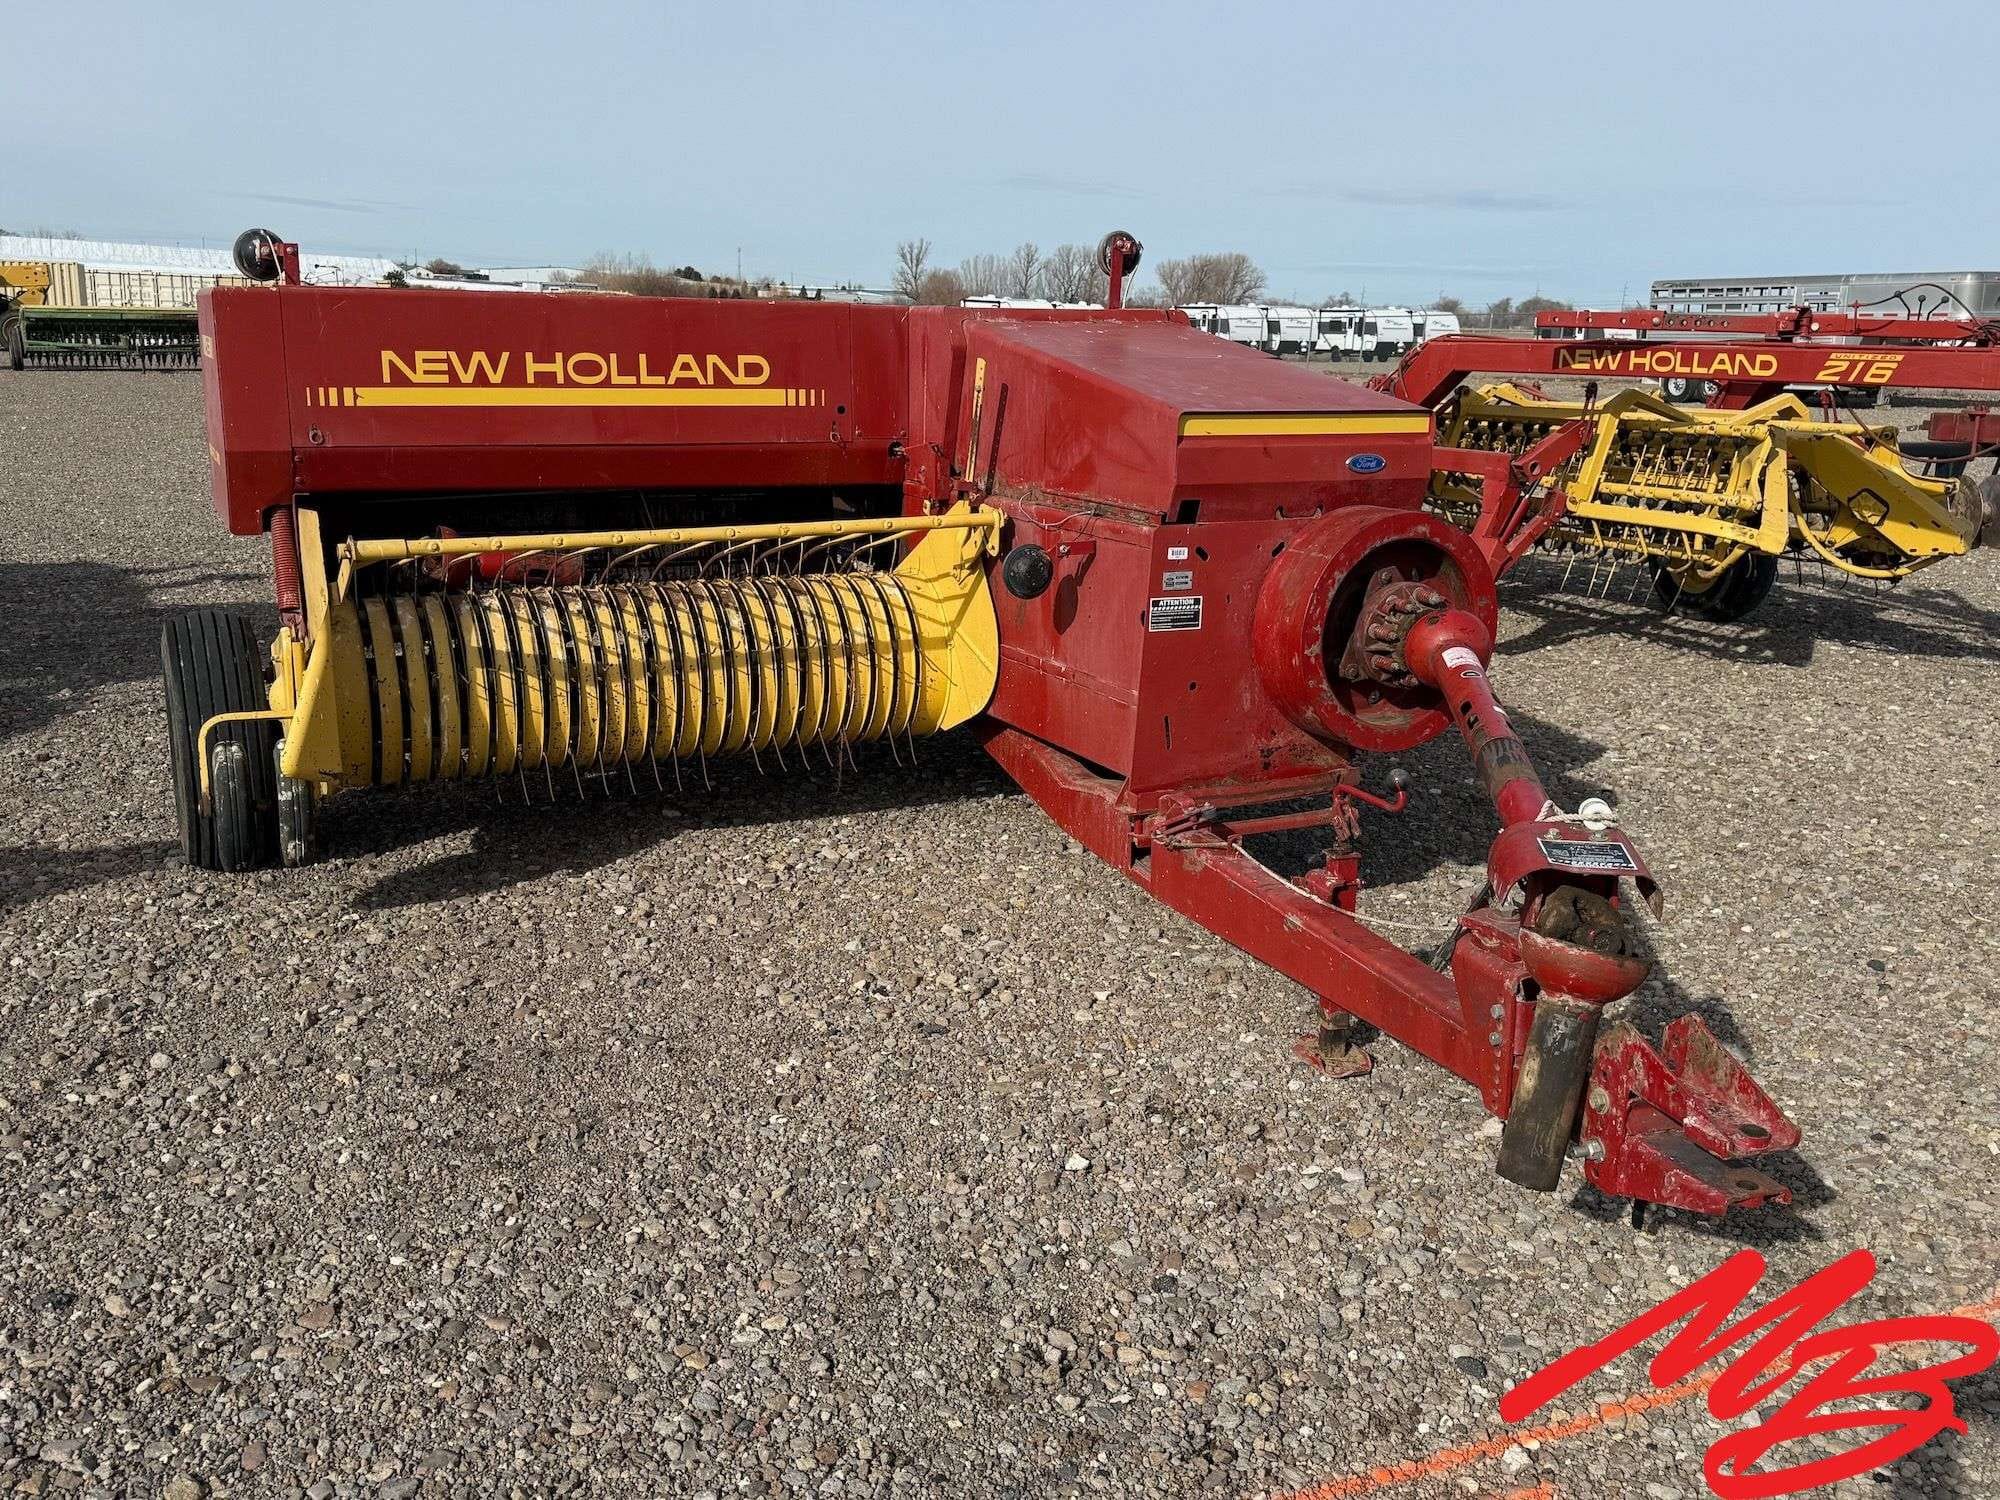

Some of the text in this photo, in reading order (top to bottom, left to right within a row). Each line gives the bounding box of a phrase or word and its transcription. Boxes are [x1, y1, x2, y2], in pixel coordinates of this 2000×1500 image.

[1558, 348, 1778, 377] NEW HOLLAND
[1834, 353, 1898, 361] UNITIZED
[381, 350, 771, 386] NEW HOLLAND
[1815, 360, 1899, 384] 216
[1356, 457, 1377, 469] Ford
[1158, 598, 1195, 606] ATTENTION
